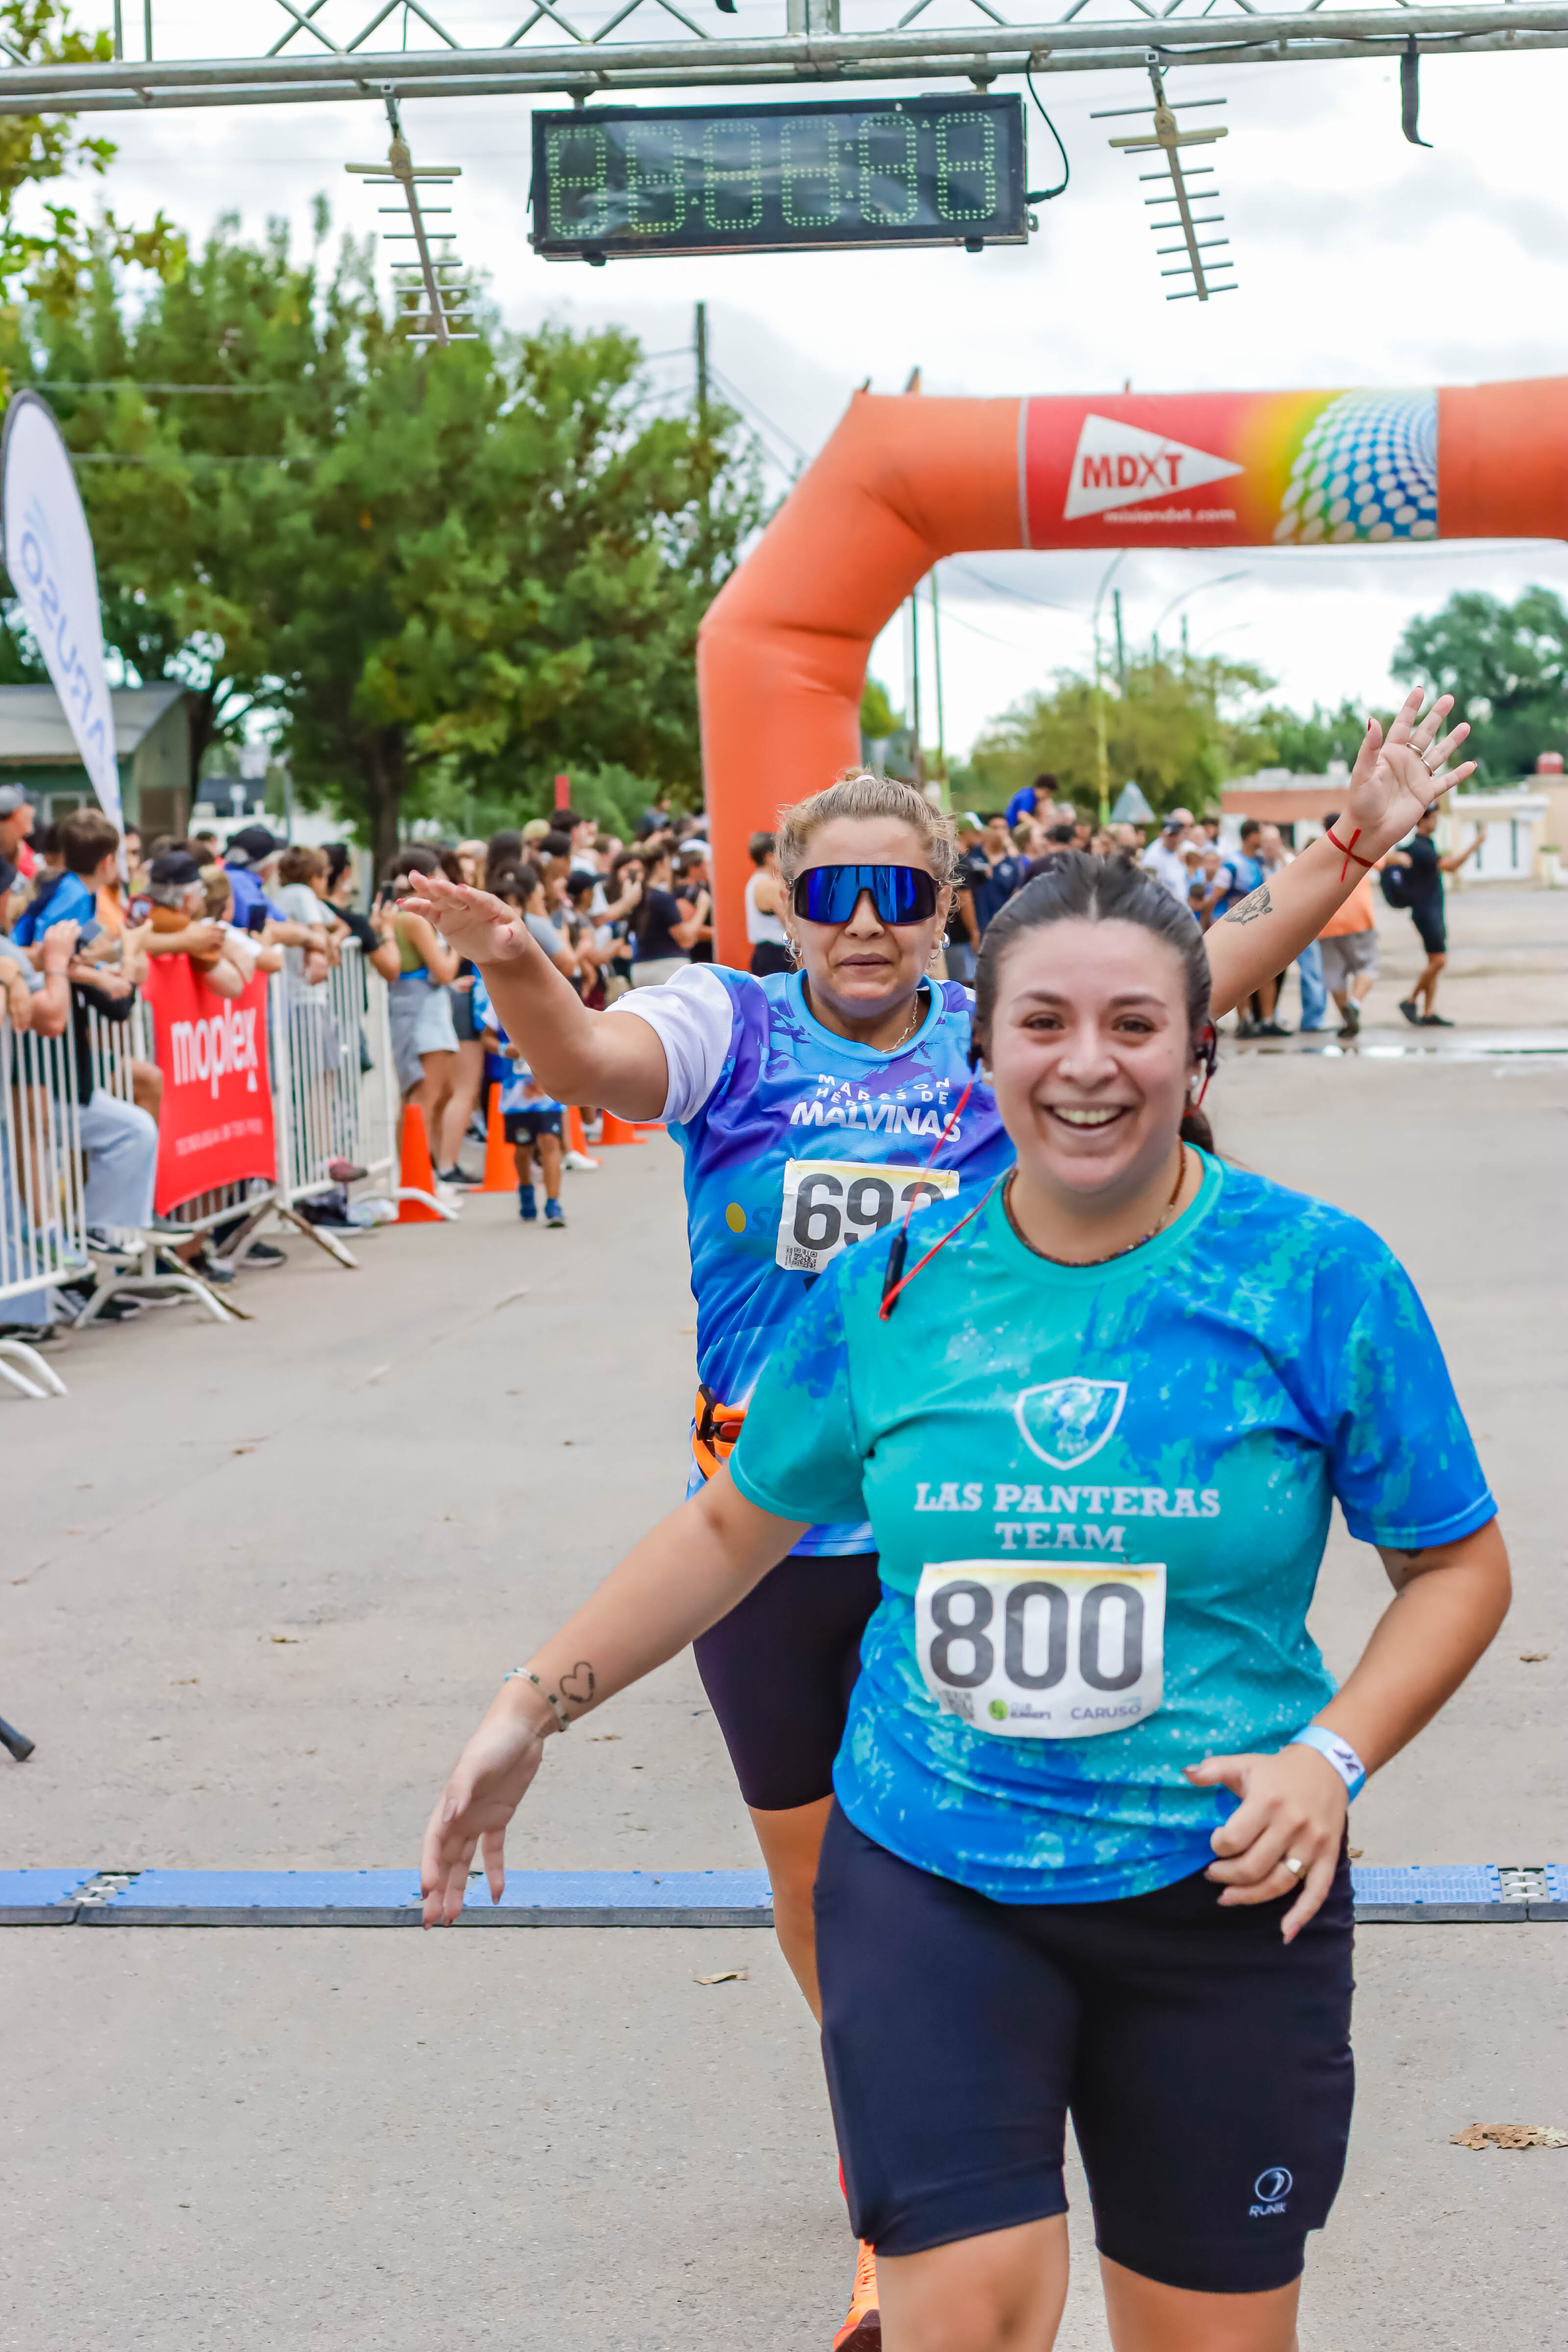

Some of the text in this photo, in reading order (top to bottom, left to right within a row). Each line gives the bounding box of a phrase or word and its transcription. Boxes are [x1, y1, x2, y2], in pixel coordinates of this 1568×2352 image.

[1081, 452, 1182, 489] MDXT
[171, 998, 258, 1099] moplex
[921, 1091, 949, 1105] DE
[790, 1101, 961, 1142] MALVINAS
[914, 1483, 1221, 1518] LAS PANTERAS
[994, 1522, 1126, 1552] TEAM
[930, 1580, 1144, 1691] 800
[1071, 1705, 1141, 1719] CARUSO
